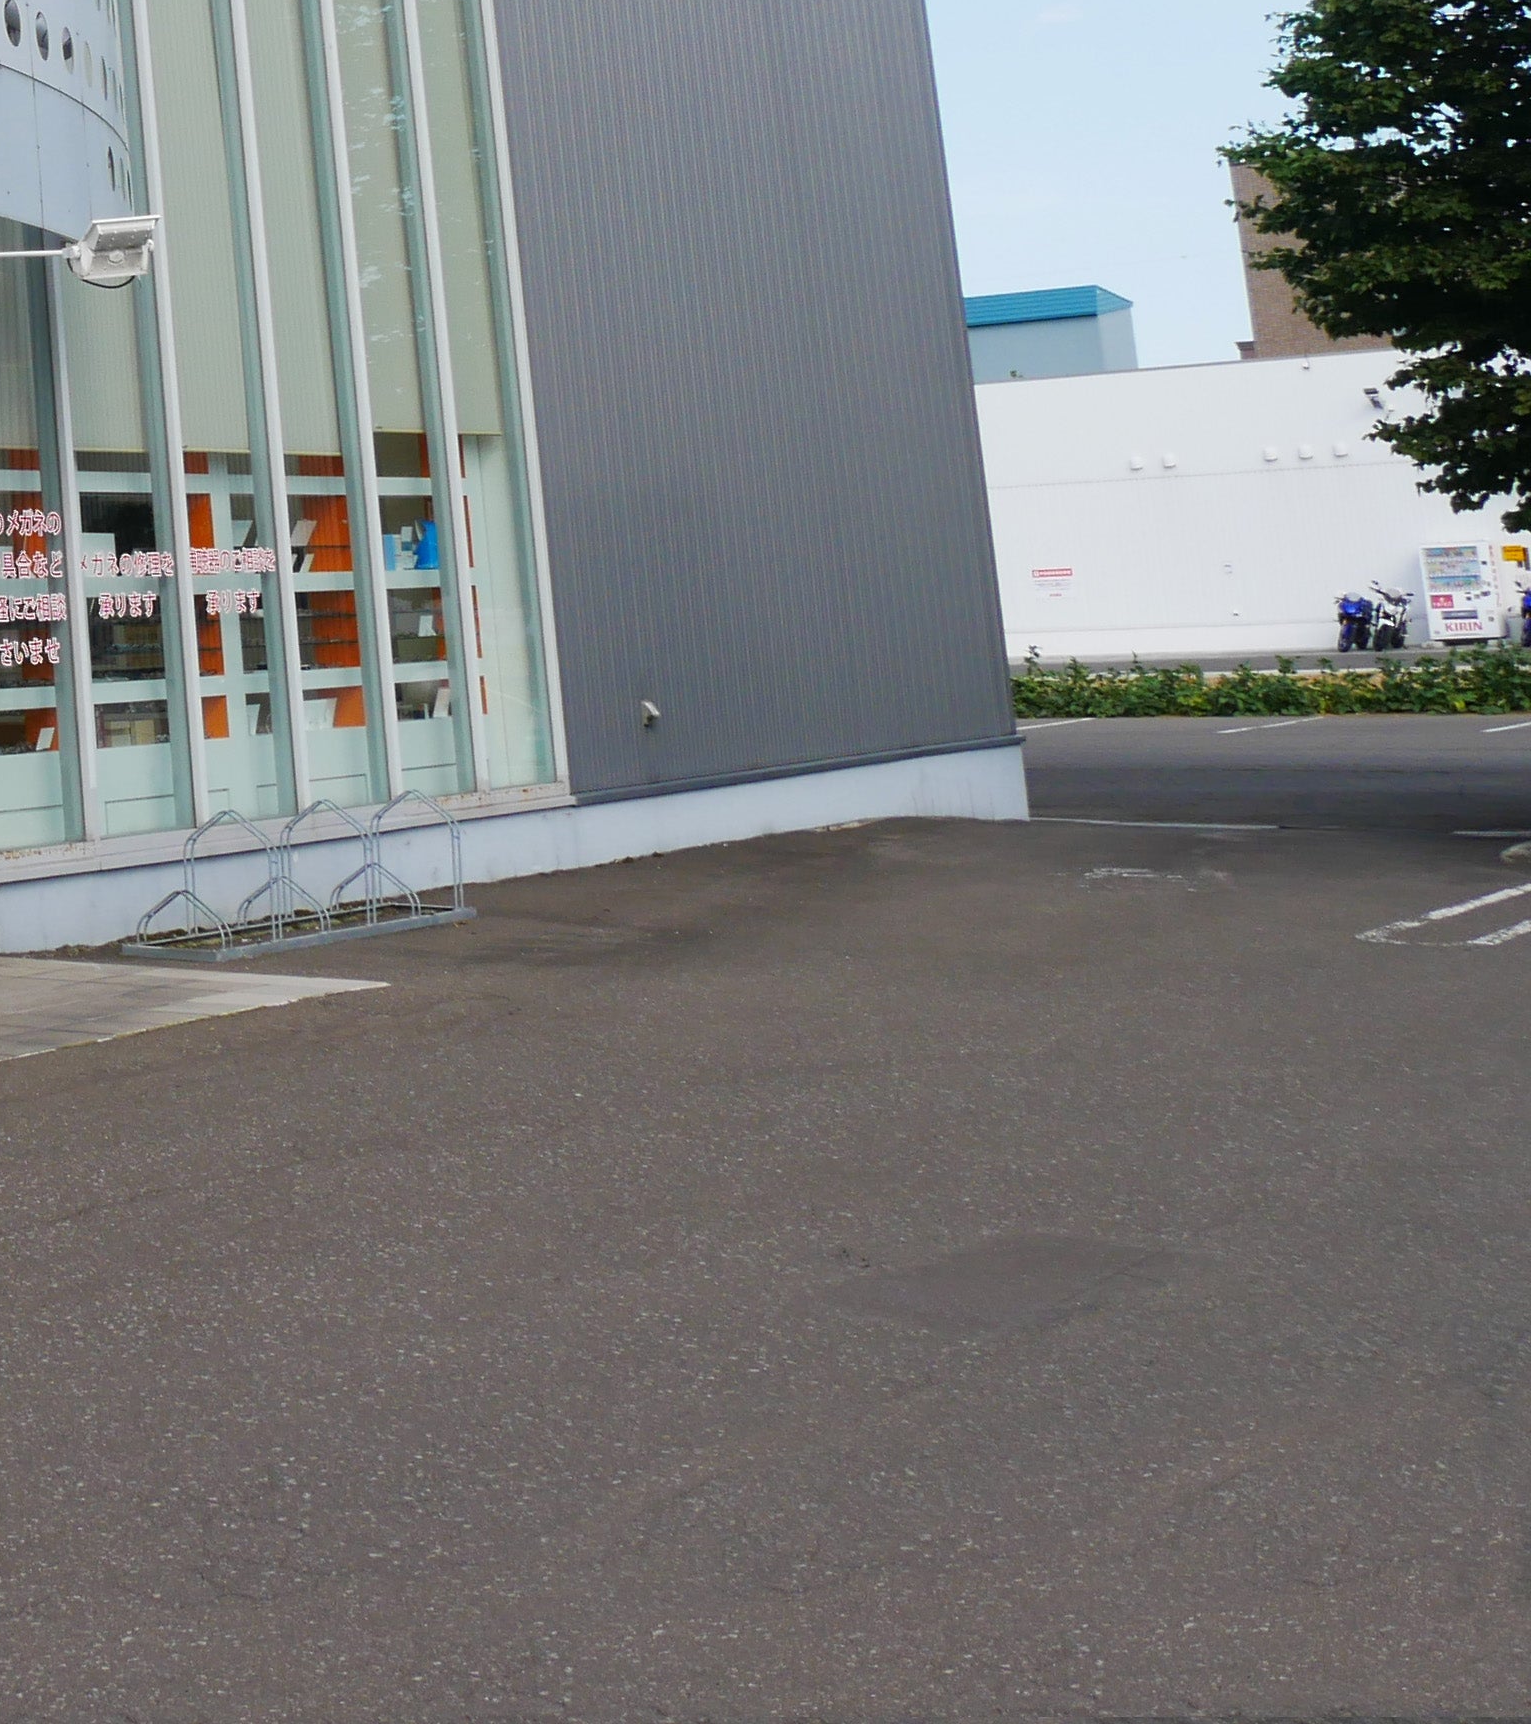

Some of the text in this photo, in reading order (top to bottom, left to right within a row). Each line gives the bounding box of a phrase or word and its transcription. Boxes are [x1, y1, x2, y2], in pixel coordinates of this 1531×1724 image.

[98, 590, 157, 619] 承ります
[206, 588, 261, 615] 承ります
[1444, 621, 1484, 632] KIRIN
